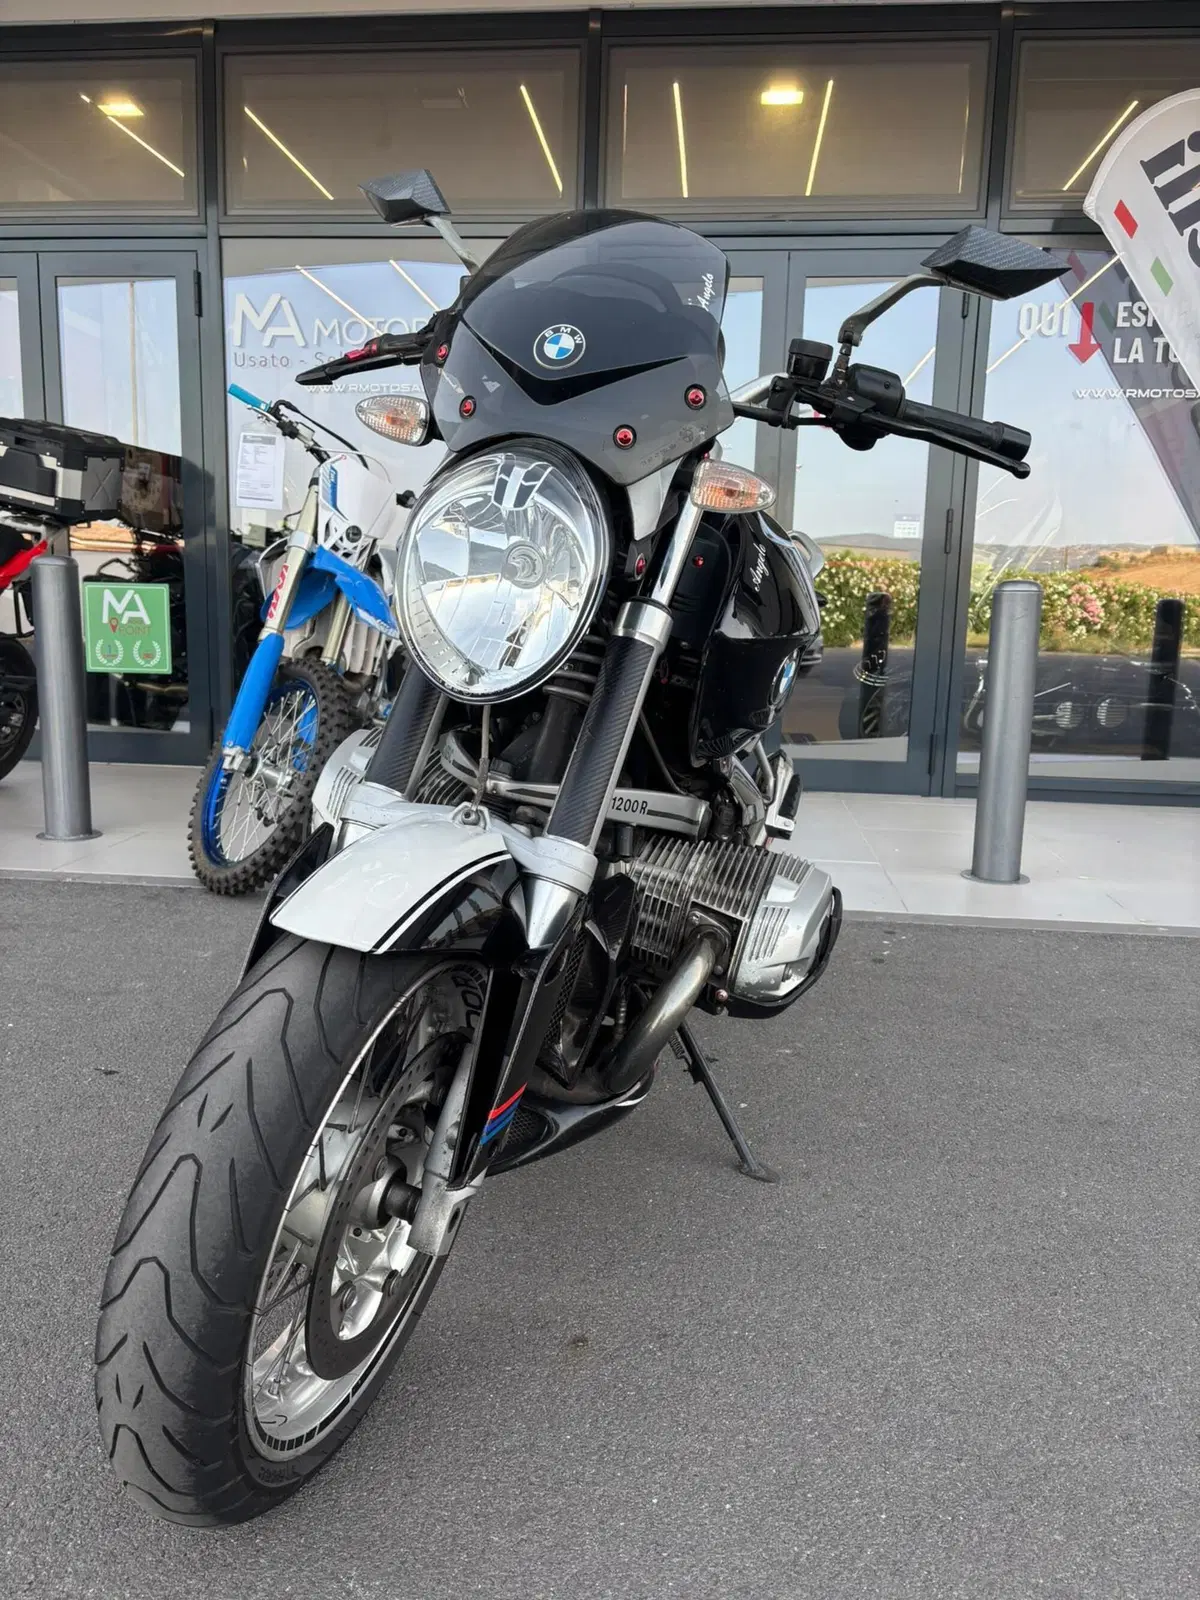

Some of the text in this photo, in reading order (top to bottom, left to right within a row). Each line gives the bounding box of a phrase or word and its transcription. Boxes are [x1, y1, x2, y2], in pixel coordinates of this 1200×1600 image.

[1018, 301, 1072, 340] QUI
[234, 352, 290, 368] Usato
[1113, 337, 1145, 364] LA
